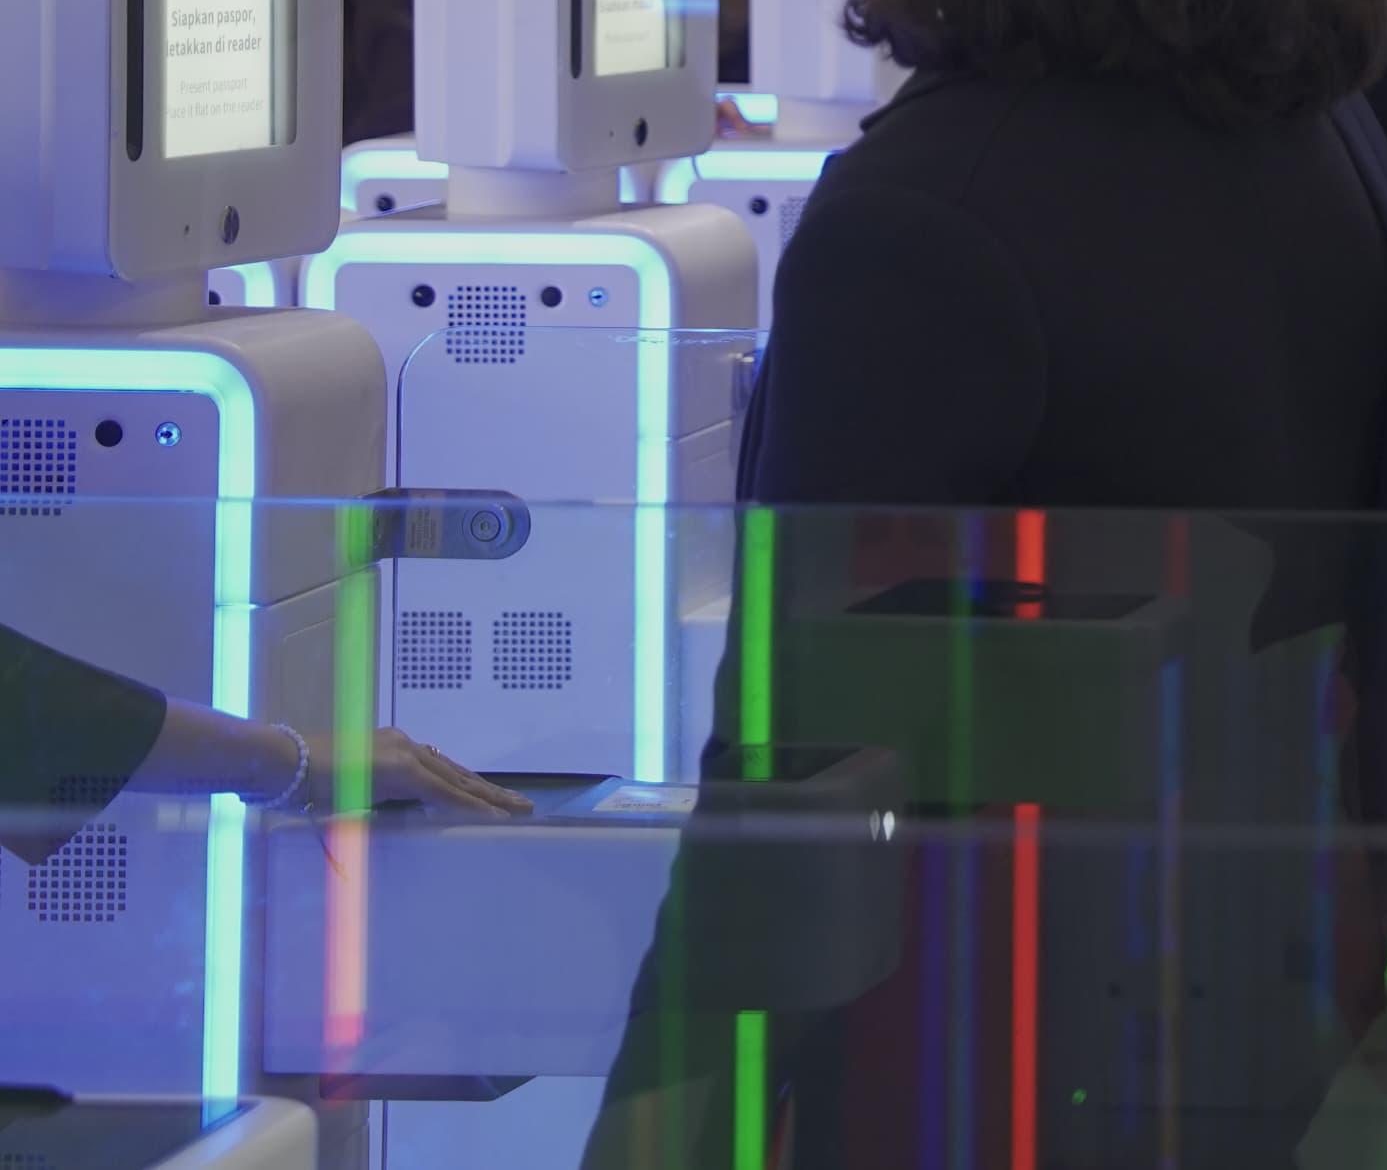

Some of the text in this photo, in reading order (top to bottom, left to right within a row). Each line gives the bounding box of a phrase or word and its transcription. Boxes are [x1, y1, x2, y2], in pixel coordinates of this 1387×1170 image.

[171, 7, 256, 29] Siapkan paspor,
[215, 34, 225, 53] di
[227, 33, 262, 52] reader
[180, 80, 210, 94] Present
